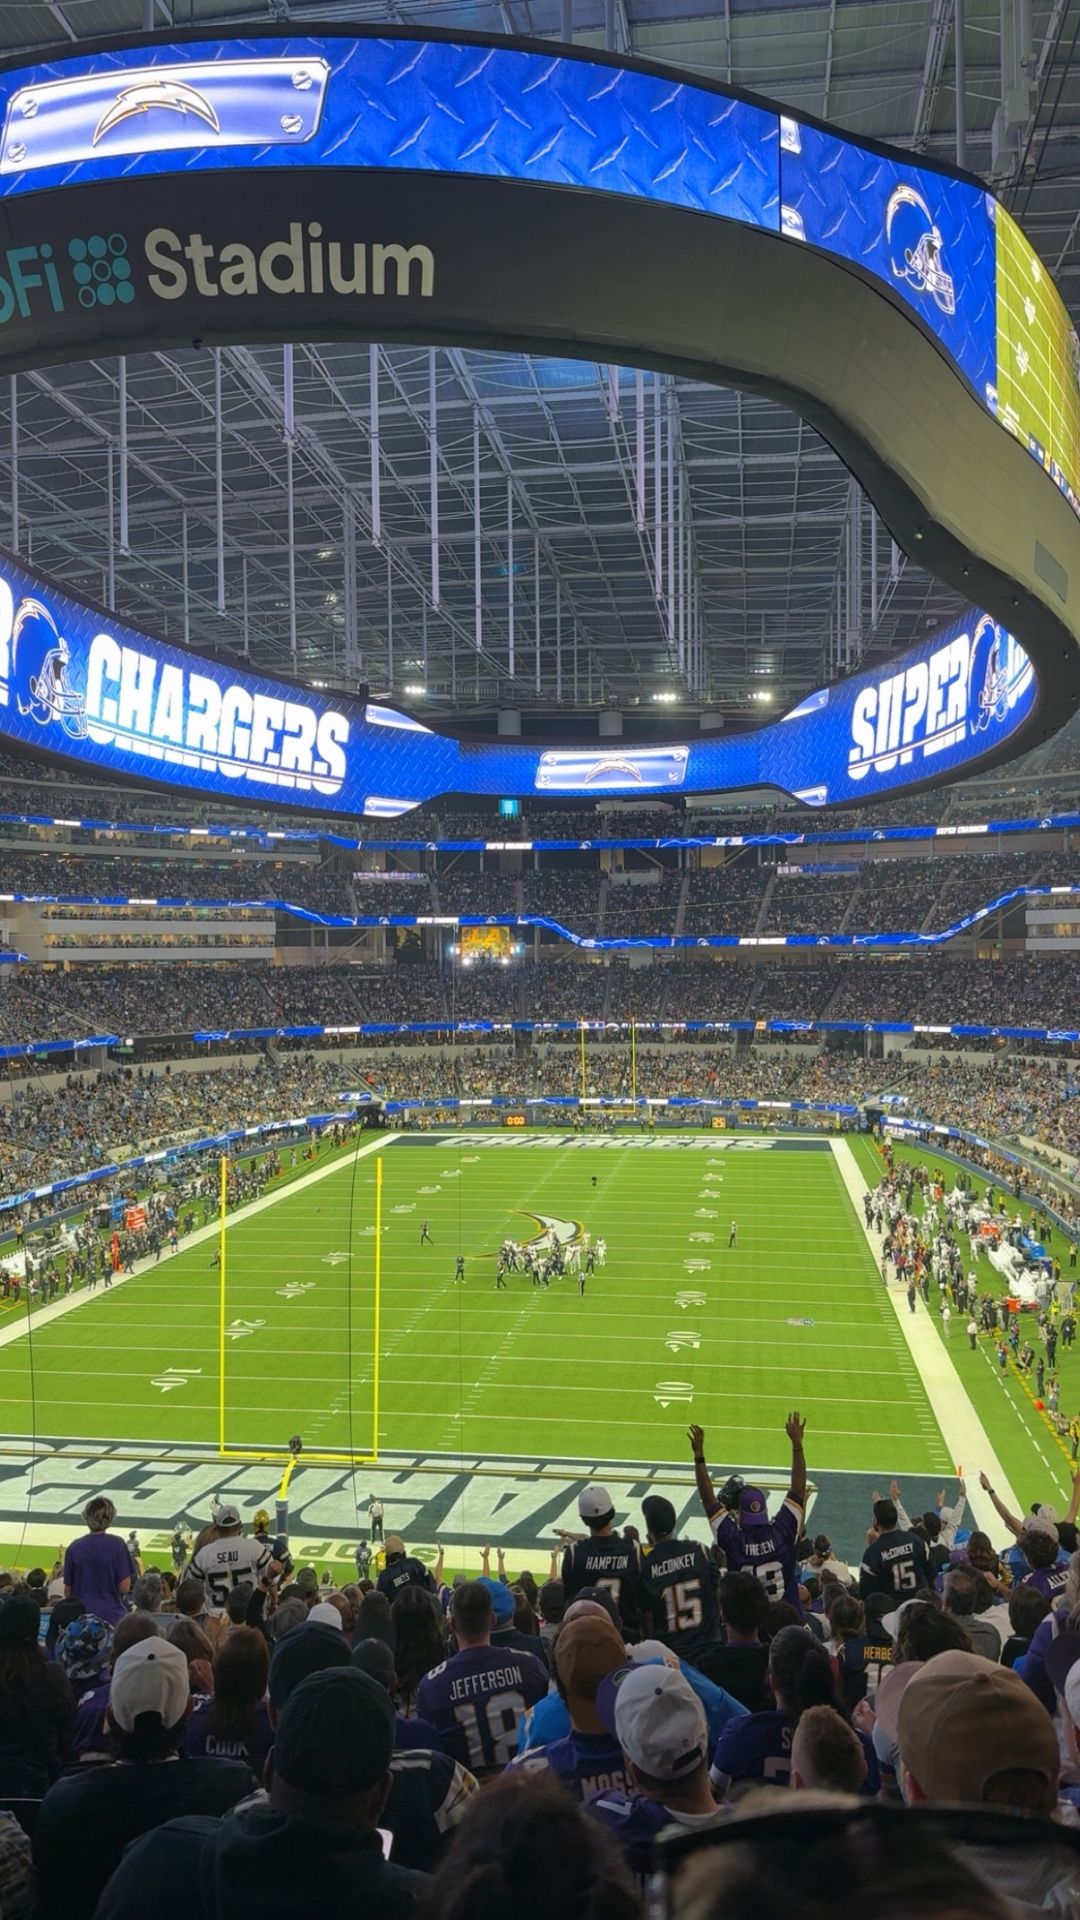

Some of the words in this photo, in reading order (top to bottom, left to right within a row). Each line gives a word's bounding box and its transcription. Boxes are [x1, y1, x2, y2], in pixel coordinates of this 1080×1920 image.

[145, 221, 435, 299] Stadium
[87, 634, 349, 795] CHARGERS
[848, 633, 970, 780] SUPER
[436, 1136, 777, 1151] CHARGERS
[674, 1291, 707, 1306] 30
[223, 1319, 267, 1336] 20
[664, 1331, 701, 1349] 20
[150, 1367, 203, 1386] 10
[653, 1382, 694, 1403] 10
[217, 1551, 239, 1564] SEAU
[300, 1542, 439, 1562] SOP
[585, 1556, 628, 1570] HAMPTON
[651, 1553, 695, 1578] McCONKEY
[892, 1561, 917, 1591] 15
[1046, 1570, 1070, 1589] ALLE
[661, 1579, 702, 1633] 15
[863, 1646, 893, 1660] HERBE
[450, 1666, 522, 1700] JEFFERSON
[454, 1690, 526, 1768] 18
[206, 1735, 249, 1756] COOK
